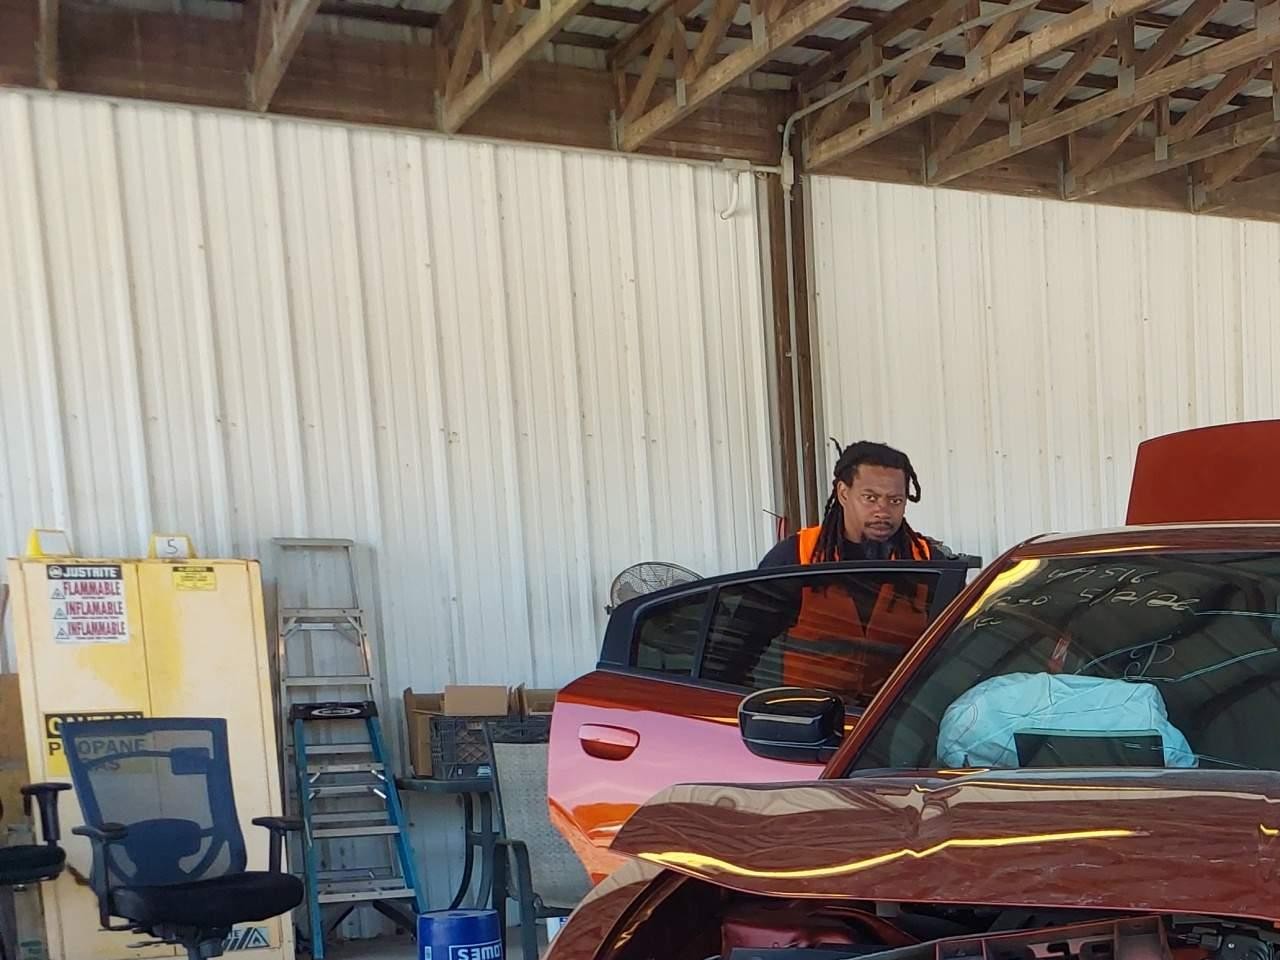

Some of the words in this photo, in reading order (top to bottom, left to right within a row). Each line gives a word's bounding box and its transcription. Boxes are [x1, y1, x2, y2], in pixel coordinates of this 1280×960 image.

[62, 566, 119, 578] JUSTRITE
[63, 581, 121, 596] FLAMMABLE
[65, 601, 124, 616] INFLAMABLE
[67, 621, 126, 636] INFLAMMABLE
[49, 737, 146, 756] POPANE
